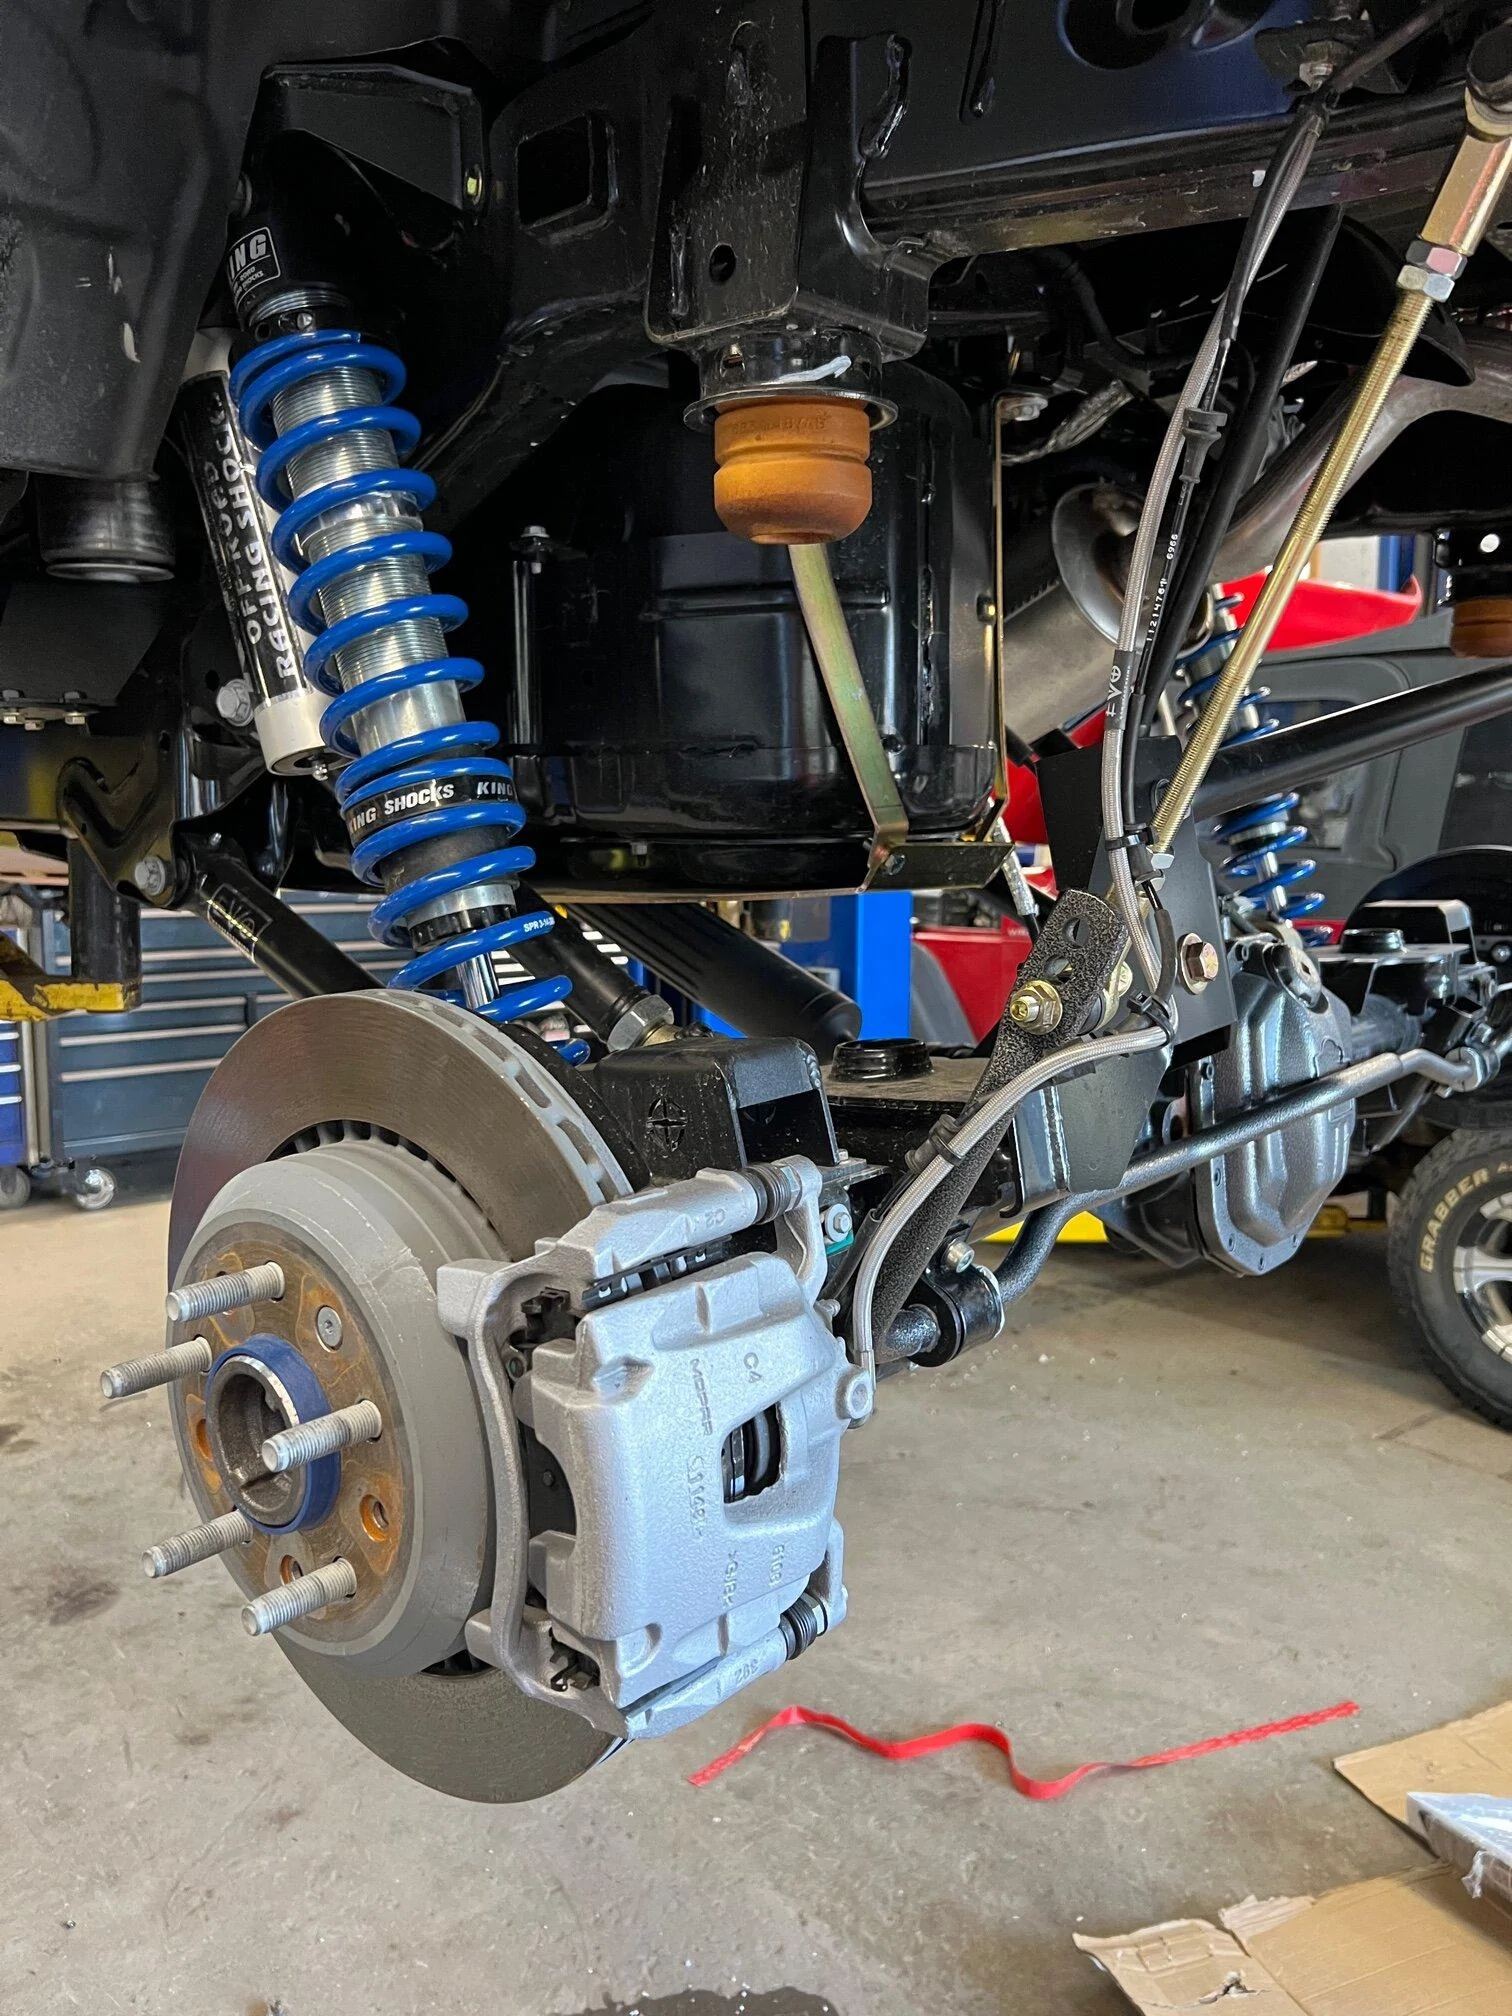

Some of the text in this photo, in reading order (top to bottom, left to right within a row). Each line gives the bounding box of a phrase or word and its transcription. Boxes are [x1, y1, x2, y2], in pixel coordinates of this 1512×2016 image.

[228, 233, 267, 280] ING
[245, 541, 298, 679] RACING
[384, 783, 455, 815] SHOCKS
[1420, 1167, 1488, 1273] GRABBER
